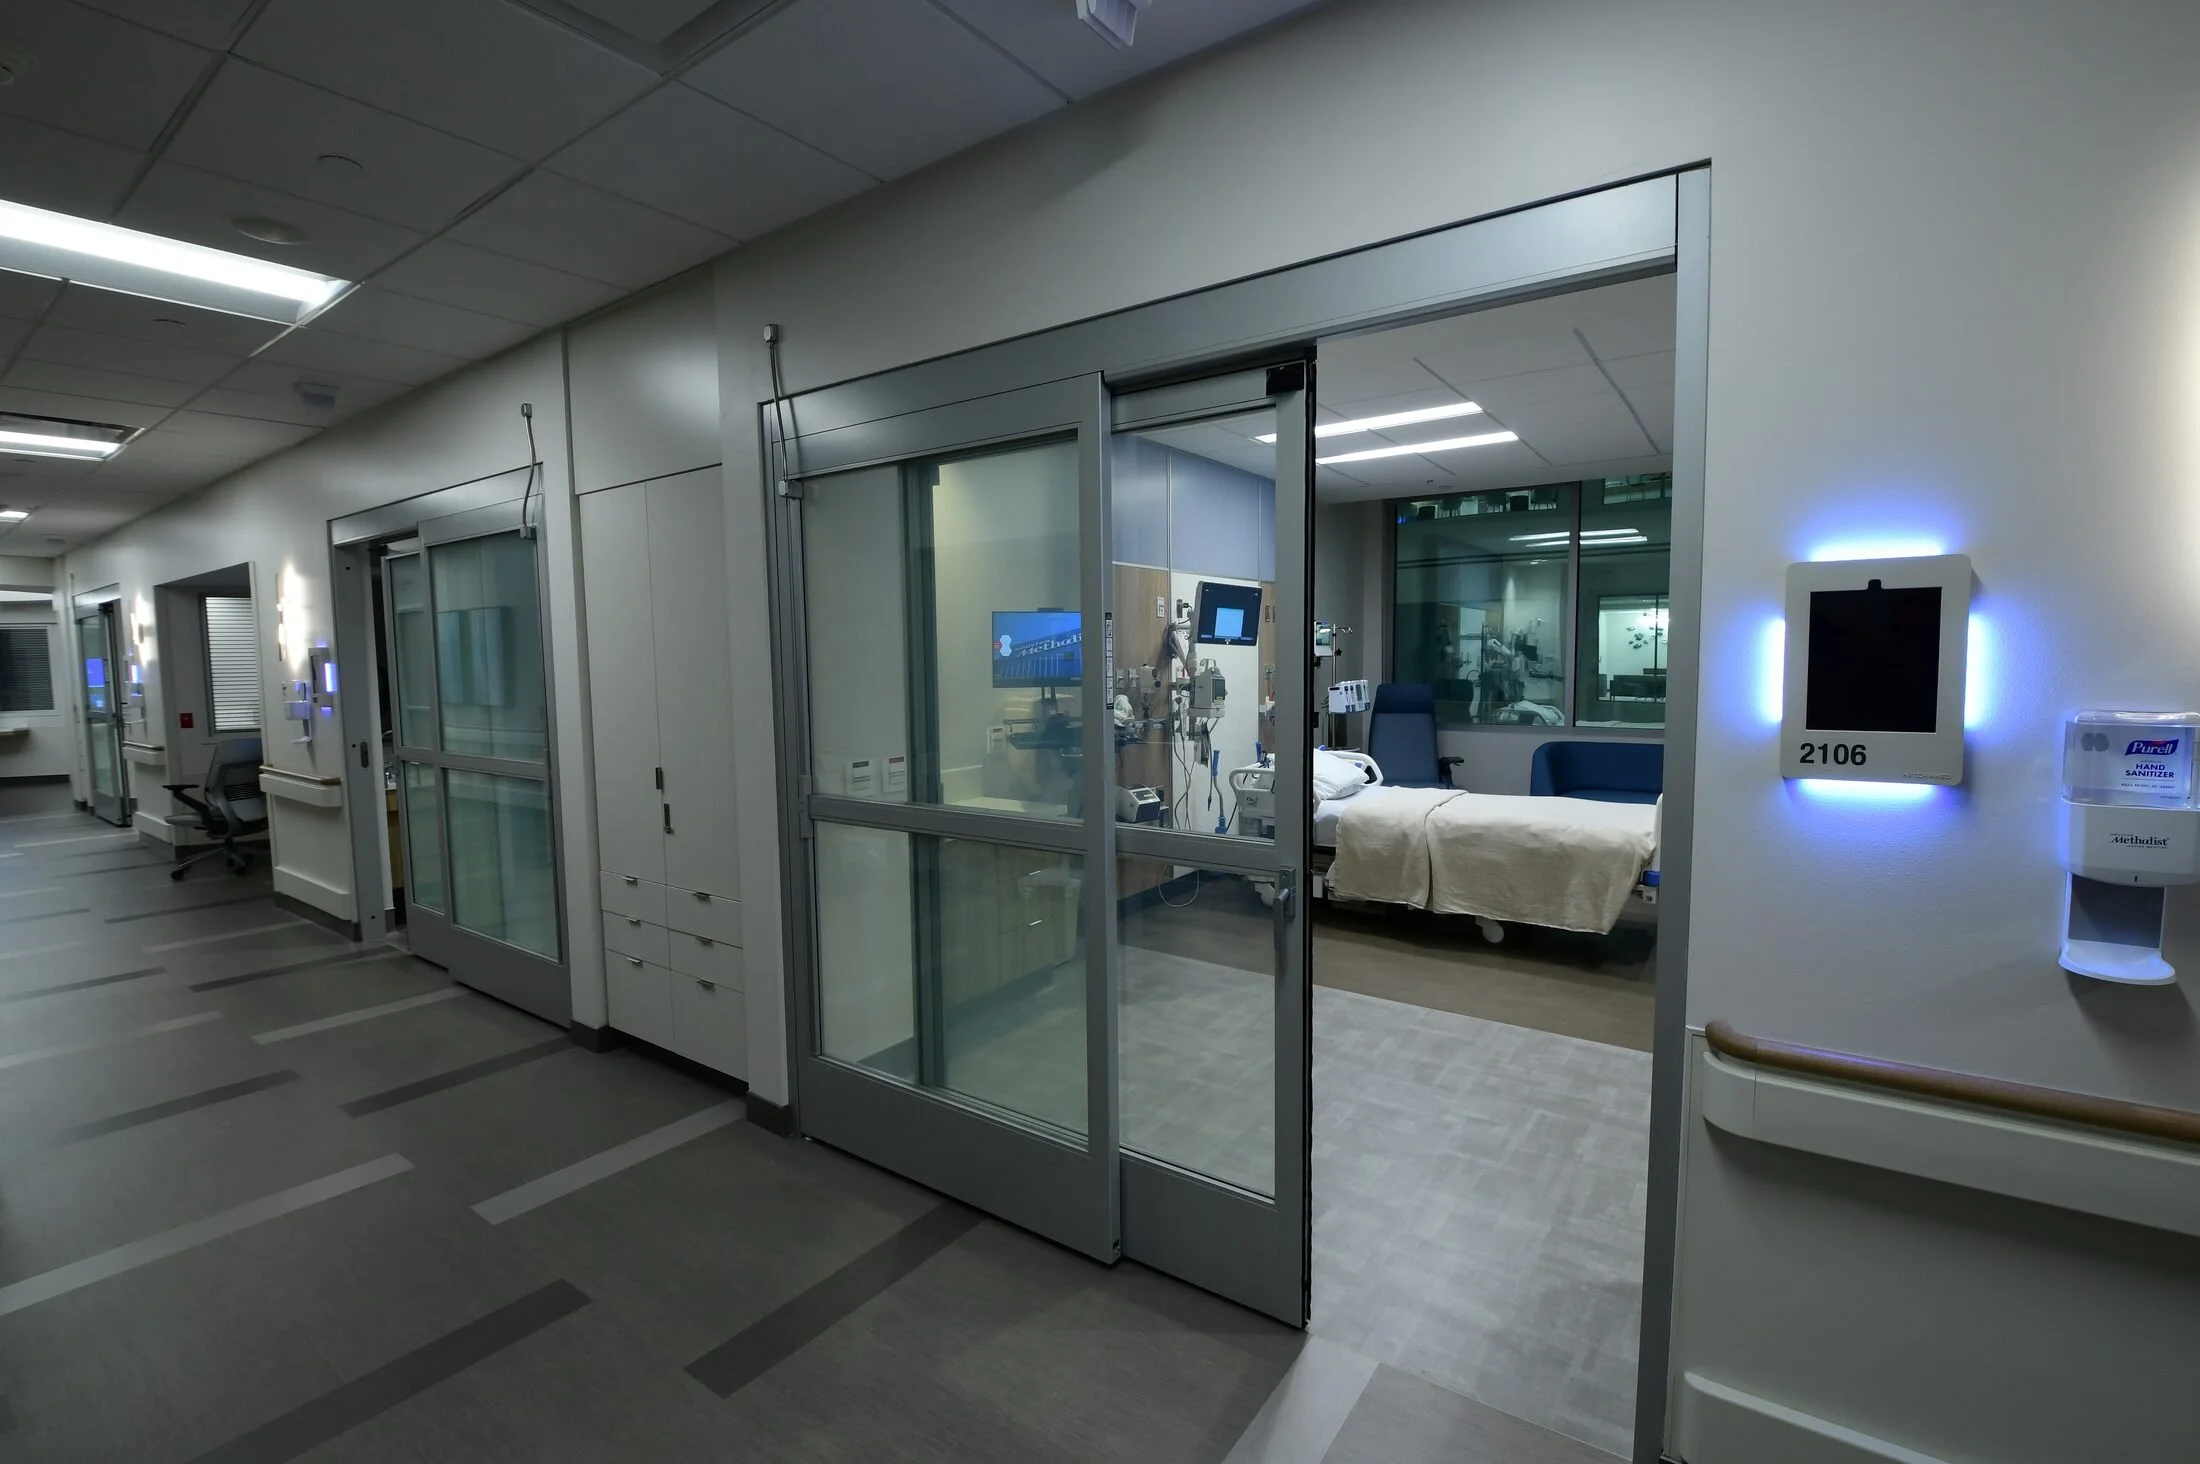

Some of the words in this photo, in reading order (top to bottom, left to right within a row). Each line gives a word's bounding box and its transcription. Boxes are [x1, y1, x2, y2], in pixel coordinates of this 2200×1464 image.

[2131, 741, 2173, 754] Purell
[1799, 742, 1867, 766] 2106
[2125, 769, 2174, 778] SANITIZER
[2111, 835, 2168, 846] Methodist
